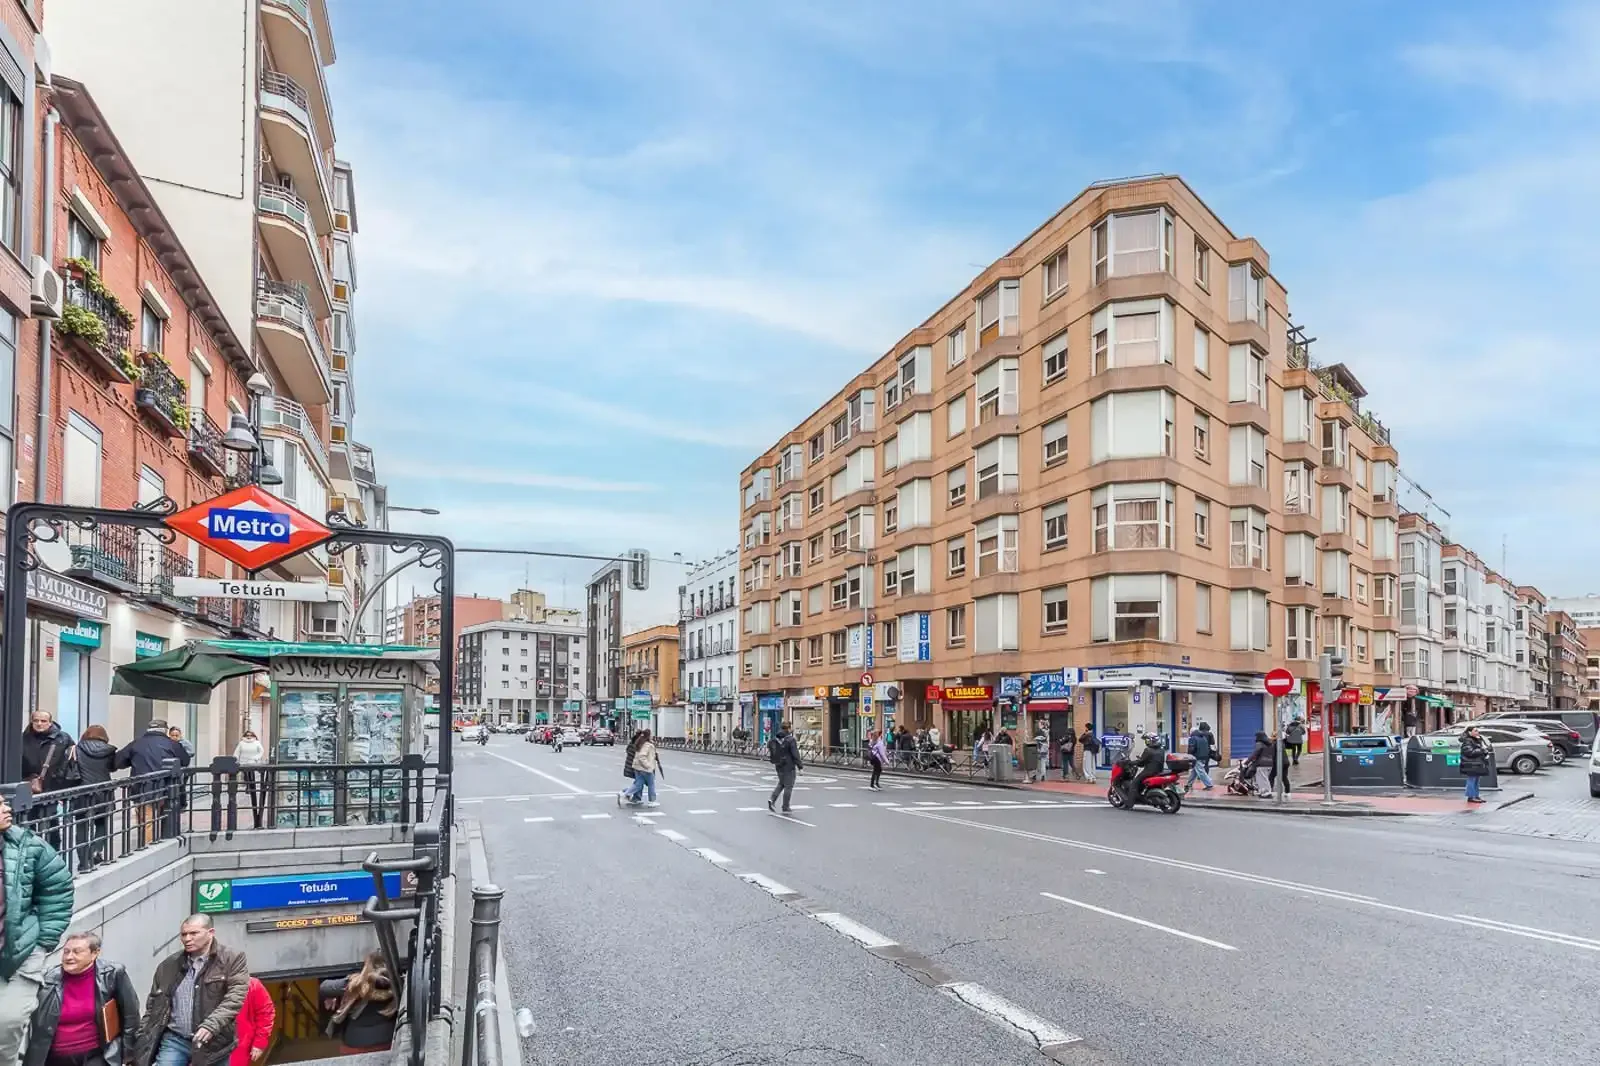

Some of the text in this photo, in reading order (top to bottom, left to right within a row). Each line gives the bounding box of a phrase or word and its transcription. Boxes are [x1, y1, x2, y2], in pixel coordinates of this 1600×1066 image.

[213, 514, 286, 538] Metro
[39, 574, 106, 609] MURILLO
[219, 582, 286, 597] Tetuán
[954, 687, 985, 696] TABACOS
[299, 882, 338, 893] Tetuán
